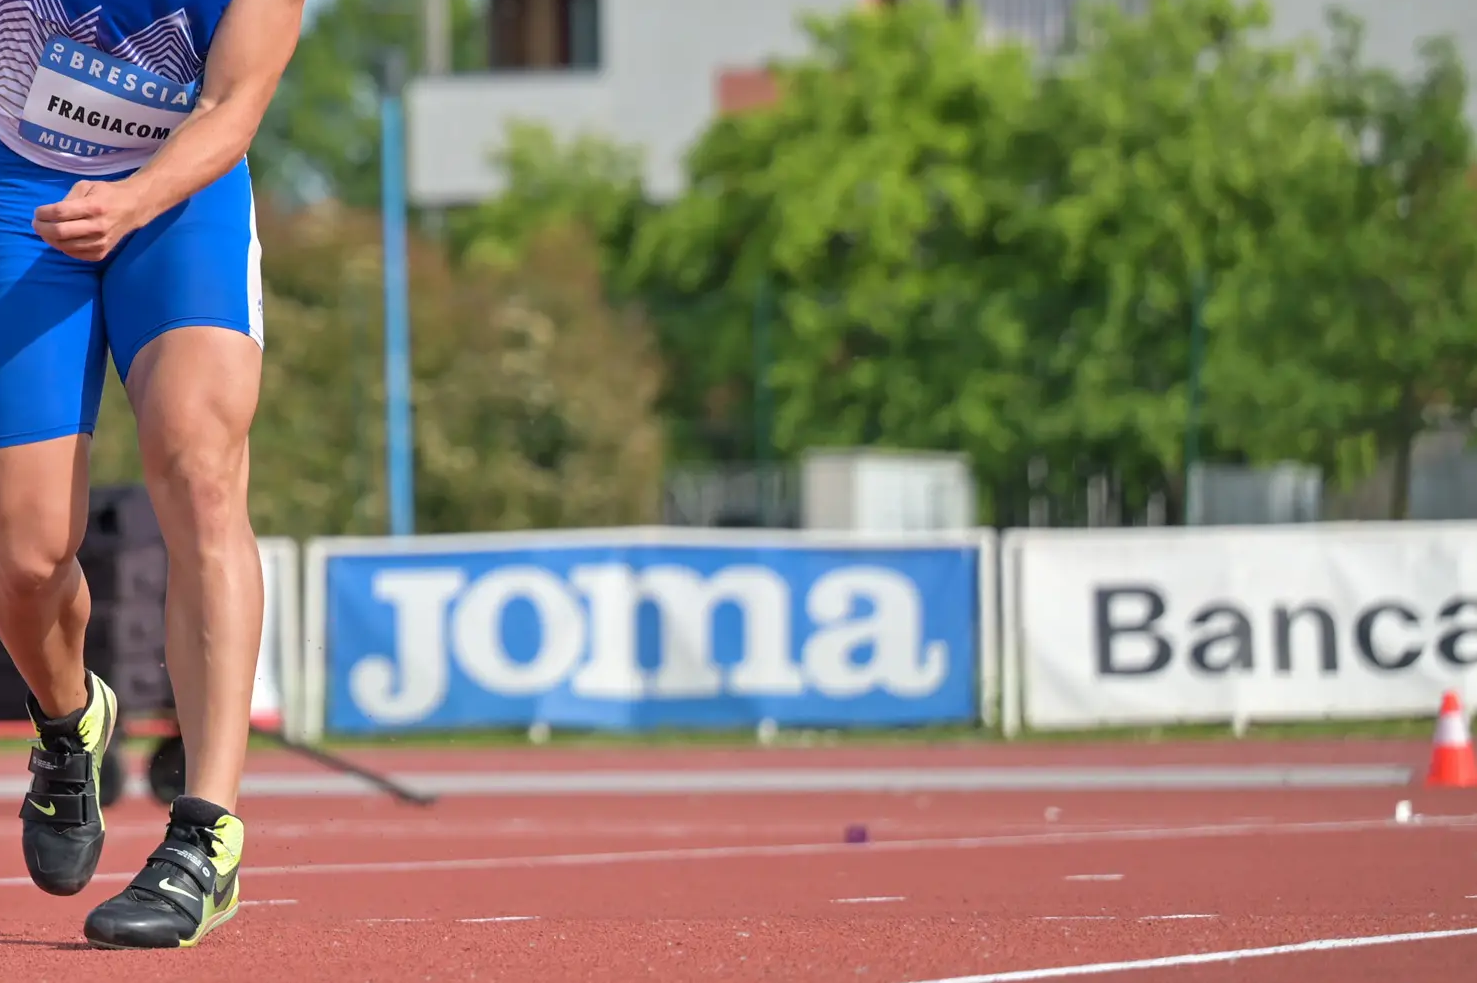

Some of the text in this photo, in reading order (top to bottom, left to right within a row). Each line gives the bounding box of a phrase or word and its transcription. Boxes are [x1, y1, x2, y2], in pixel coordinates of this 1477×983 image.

[69, 51, 189, 106] BRESCIA
[47, 95, 171, 140] FRAGIACOM
[1092, 583, 1477, 676] Banca
